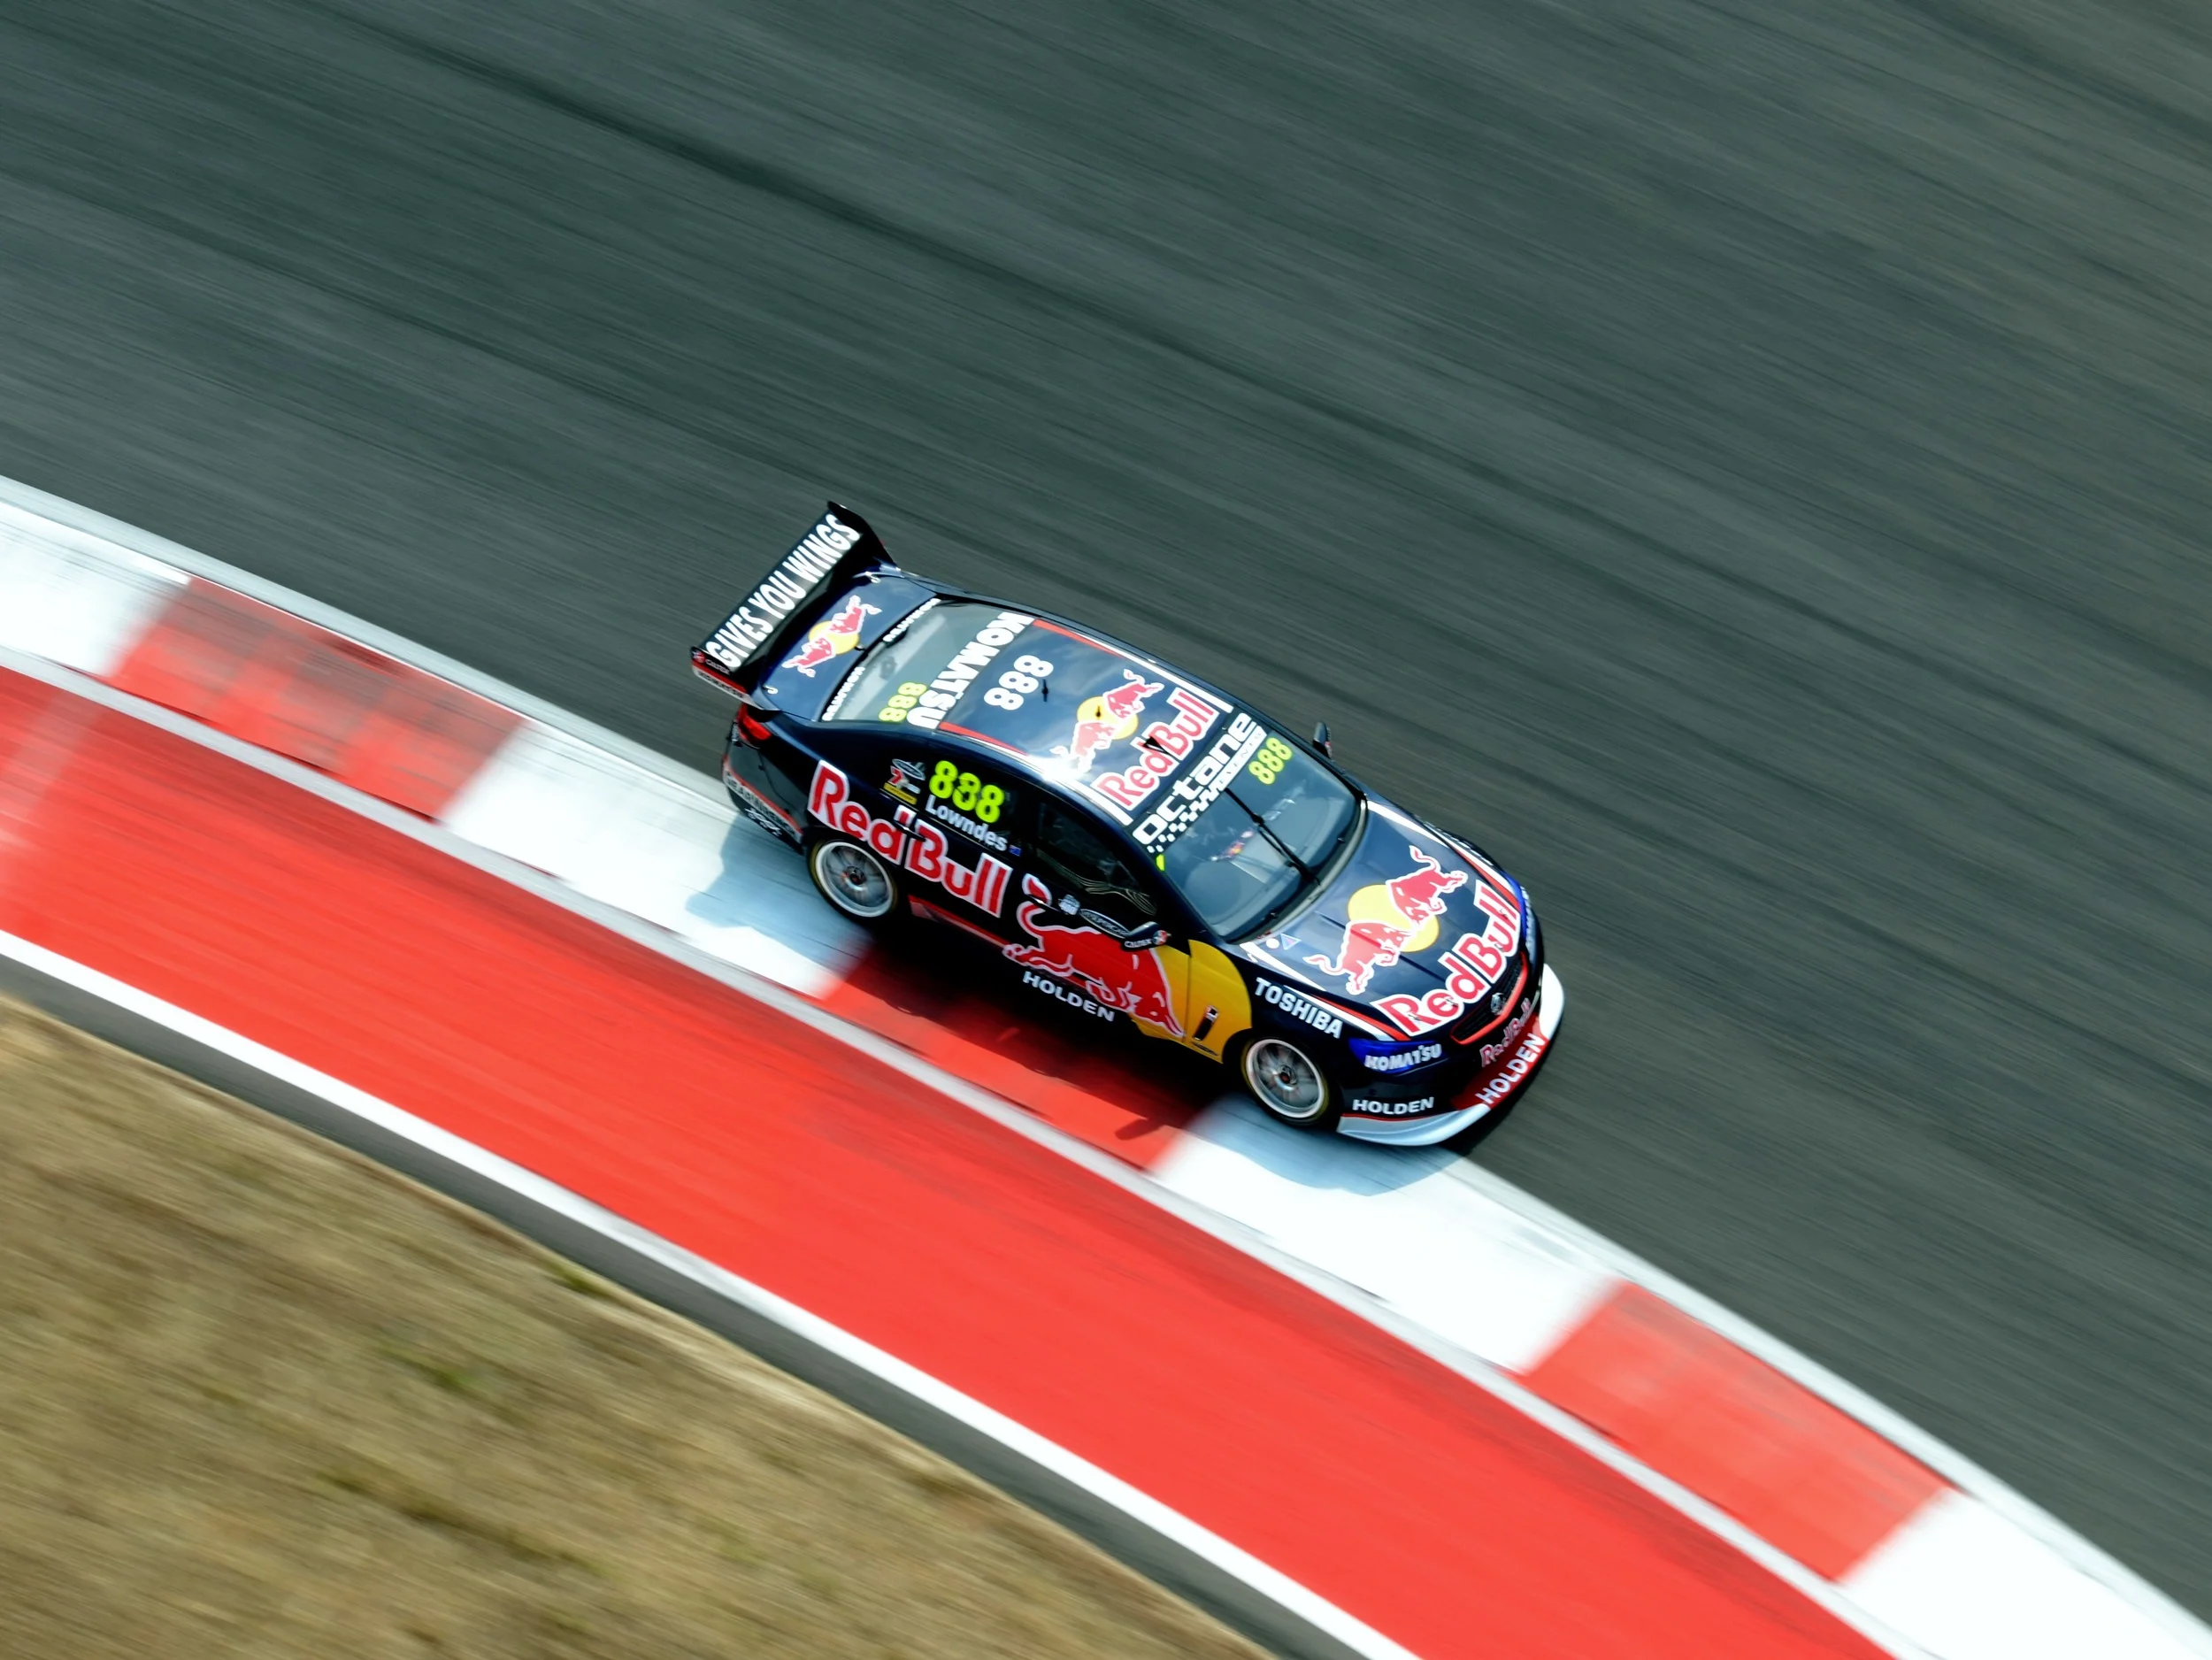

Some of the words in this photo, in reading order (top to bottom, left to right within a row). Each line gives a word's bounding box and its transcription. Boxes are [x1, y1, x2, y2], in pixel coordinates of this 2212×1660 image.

[704, 605, 774, 669] GIVES
[751, 569, 807, 620] YOU
[787, 512, 862, 584] WINGS
[906, 611, 1035, 731] KOMATSU
[983, 655, 1054, 711] 888
[878, 681, 928, 723] 888
[1248, 736, 1294, 786] 888
[929, 760, 1005, 824] 888
[807, 759, 917, 866] Red
[903, 818, 1014, 918] Bull
[926, 795, 1009, 852] Lowndes
[1022, 971, 1115, 1023] HOLDEN
[1255, 977, 1344, 1040] TOSHIBA
[1364, 1043, 1442, 1072] KOMATSU
[1475, 1032, 1547, 1104] HOLDEN
[1352, 1096, 1435, 1116] HOLDEN
